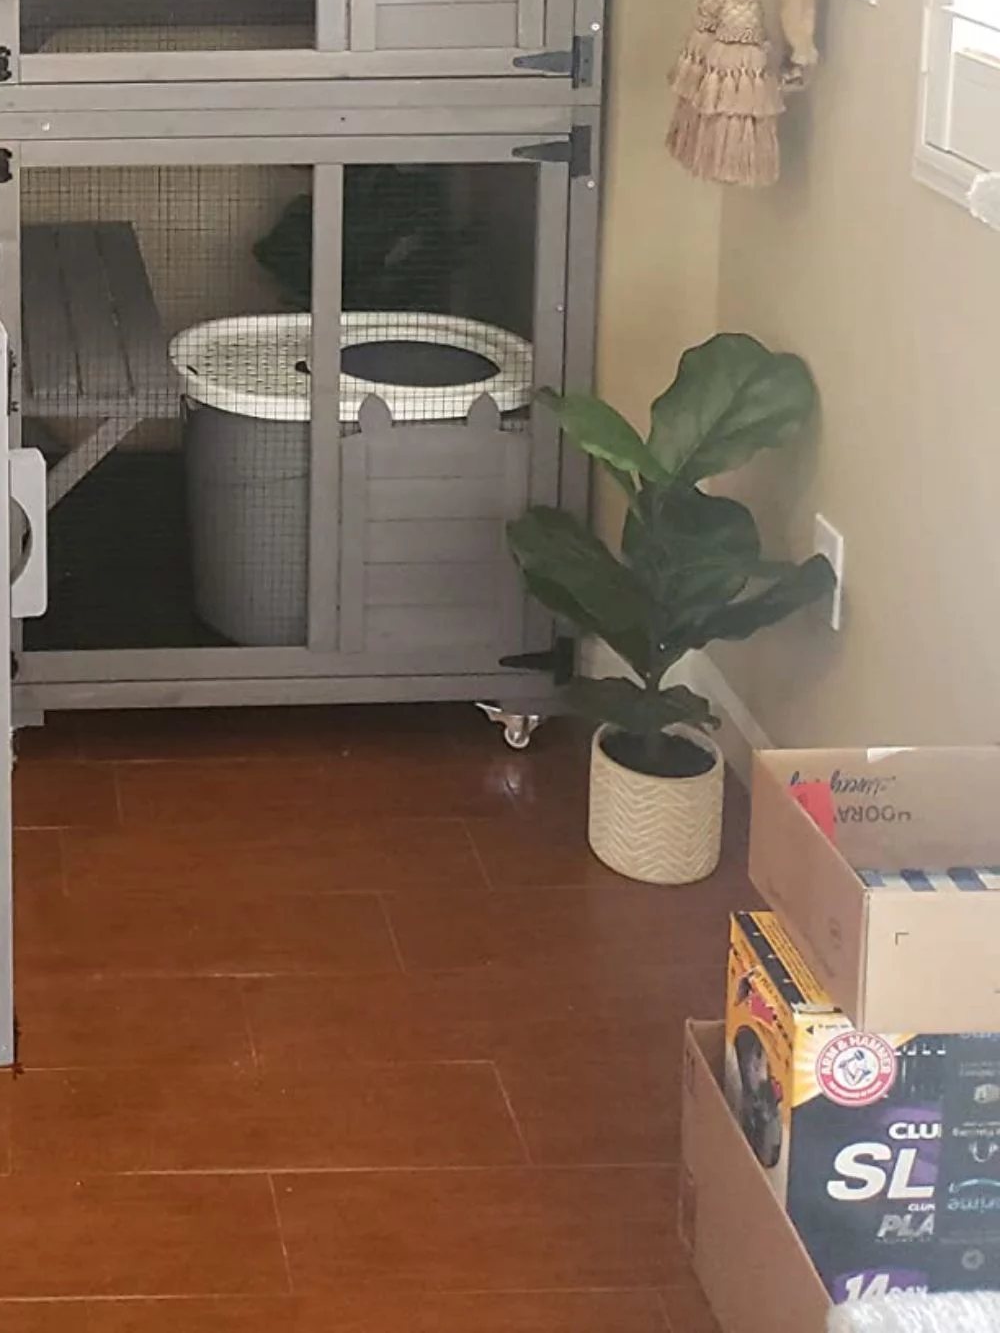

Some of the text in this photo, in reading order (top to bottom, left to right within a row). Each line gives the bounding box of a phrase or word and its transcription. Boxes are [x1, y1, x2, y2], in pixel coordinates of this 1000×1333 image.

[821, 1046, 840, 1074] ARM
[838, 1039, 850, 1051] &
[888, 1122, 942, 1140] CLU
[826, 1142, 935, 1201] SL
[876, 1214, 936, 1238] PLA
